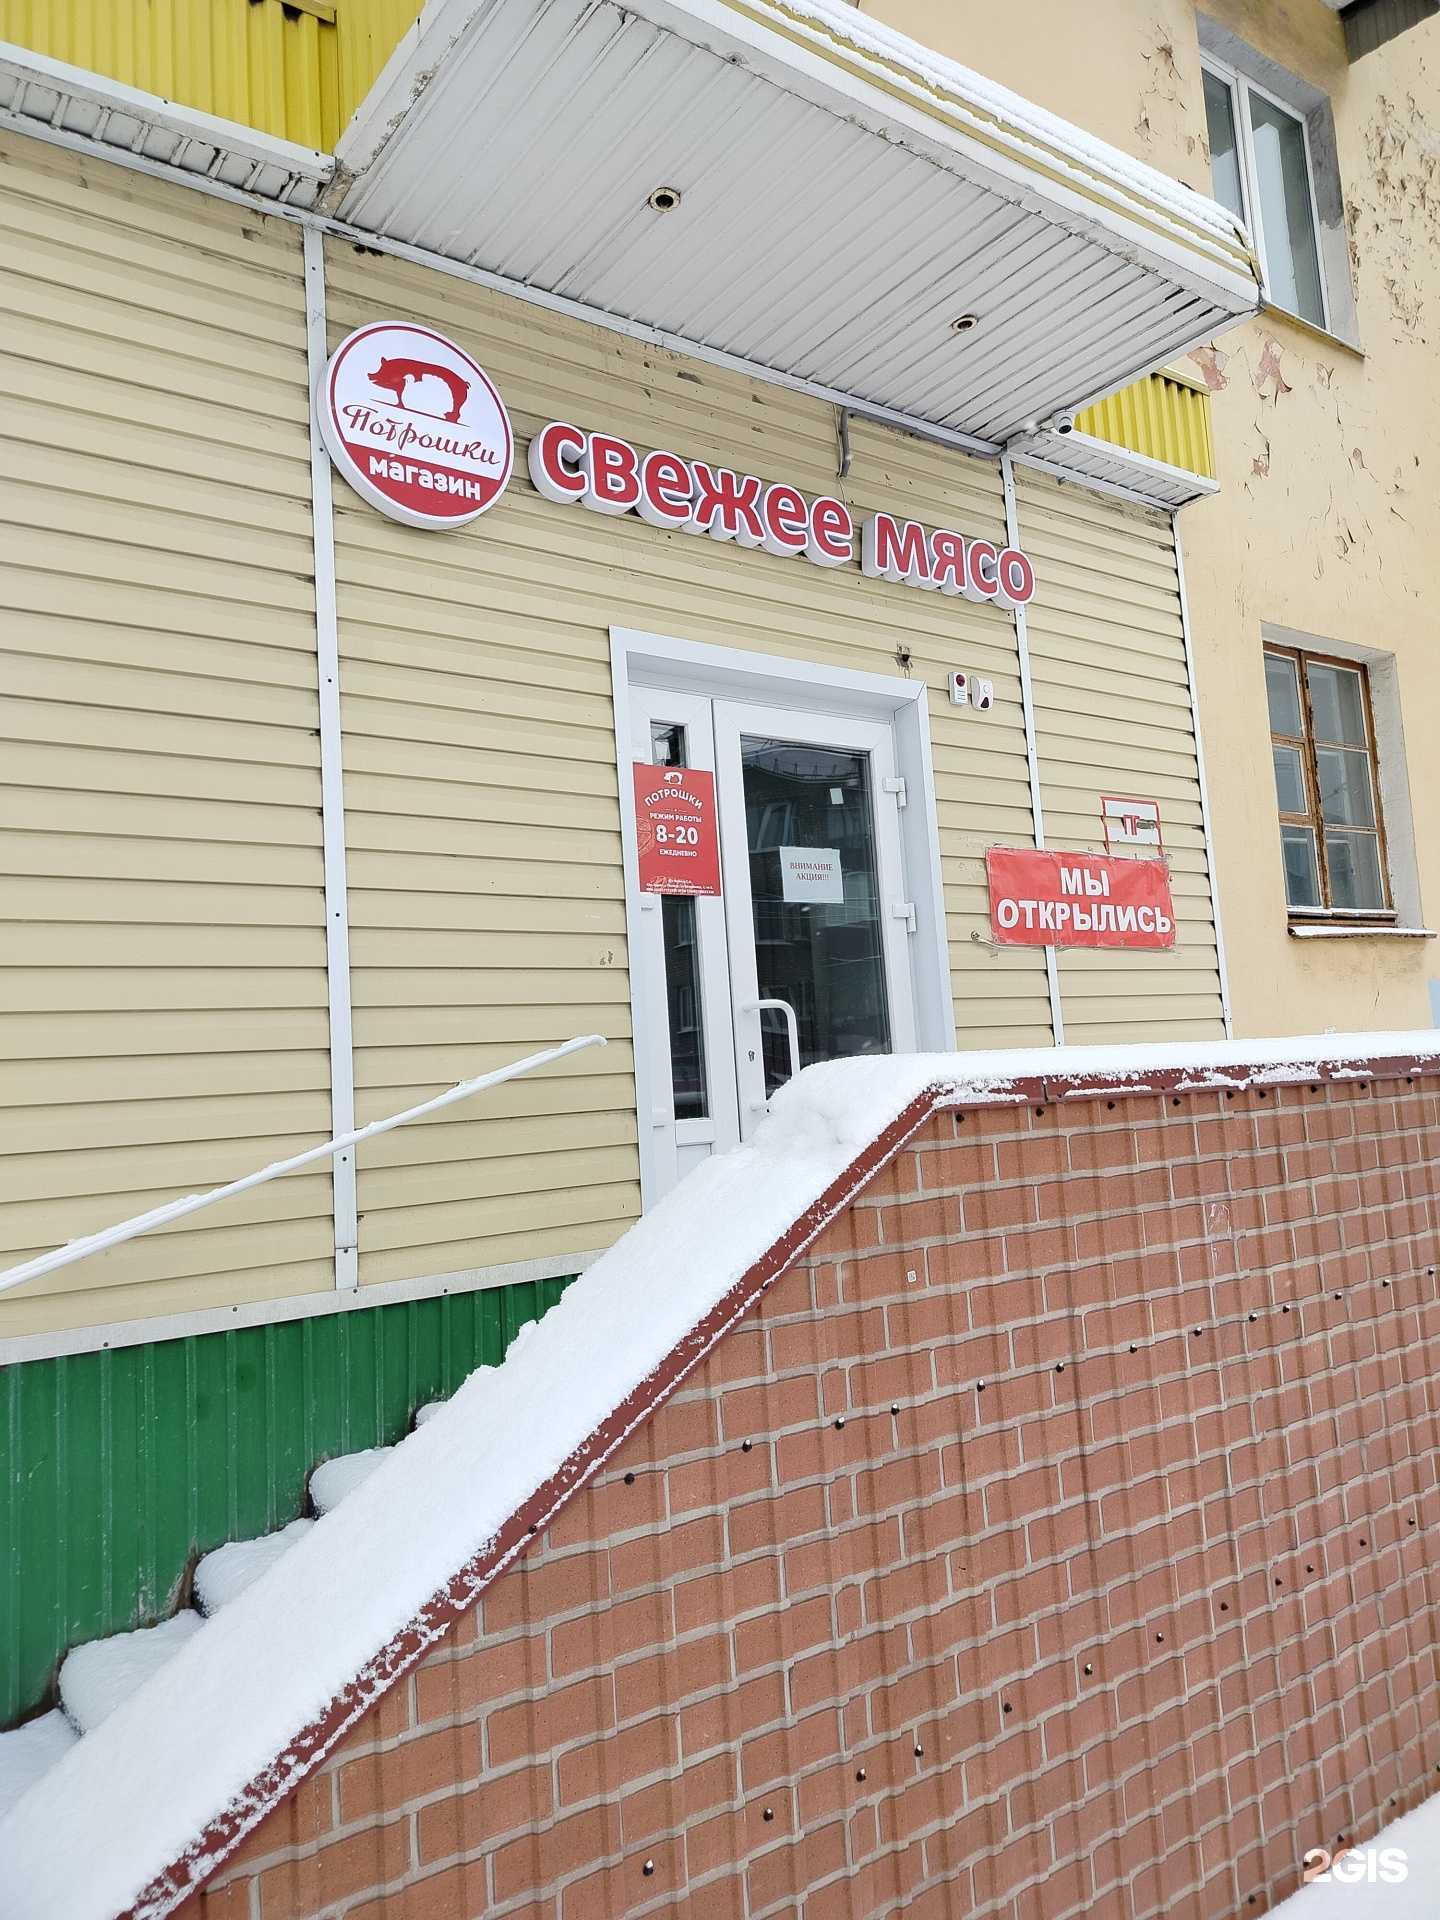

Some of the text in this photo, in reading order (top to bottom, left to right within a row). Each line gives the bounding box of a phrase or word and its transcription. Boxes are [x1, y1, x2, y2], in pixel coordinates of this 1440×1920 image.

[343, 405, 500, 465] Потрошки
[369, 455, 481, 501] магазин
[539, 422, 1036, 604] свежее мясо
[644, 788, 703, 810] ПОТРОШКИ
[649, 812, 702, 823] РЕЖИМ РАБОТЫ
[655, 824, 698, 845] 8-20
[659, 848, 698, 857] ЕЖЕДНЕВНО
[790, 862, 833, 871] ВНИМАНИЕ
[1060, 867, 1110, 897] МЫ
[997, 898, 1171, 934] ОТКРЫЛИСЬ
